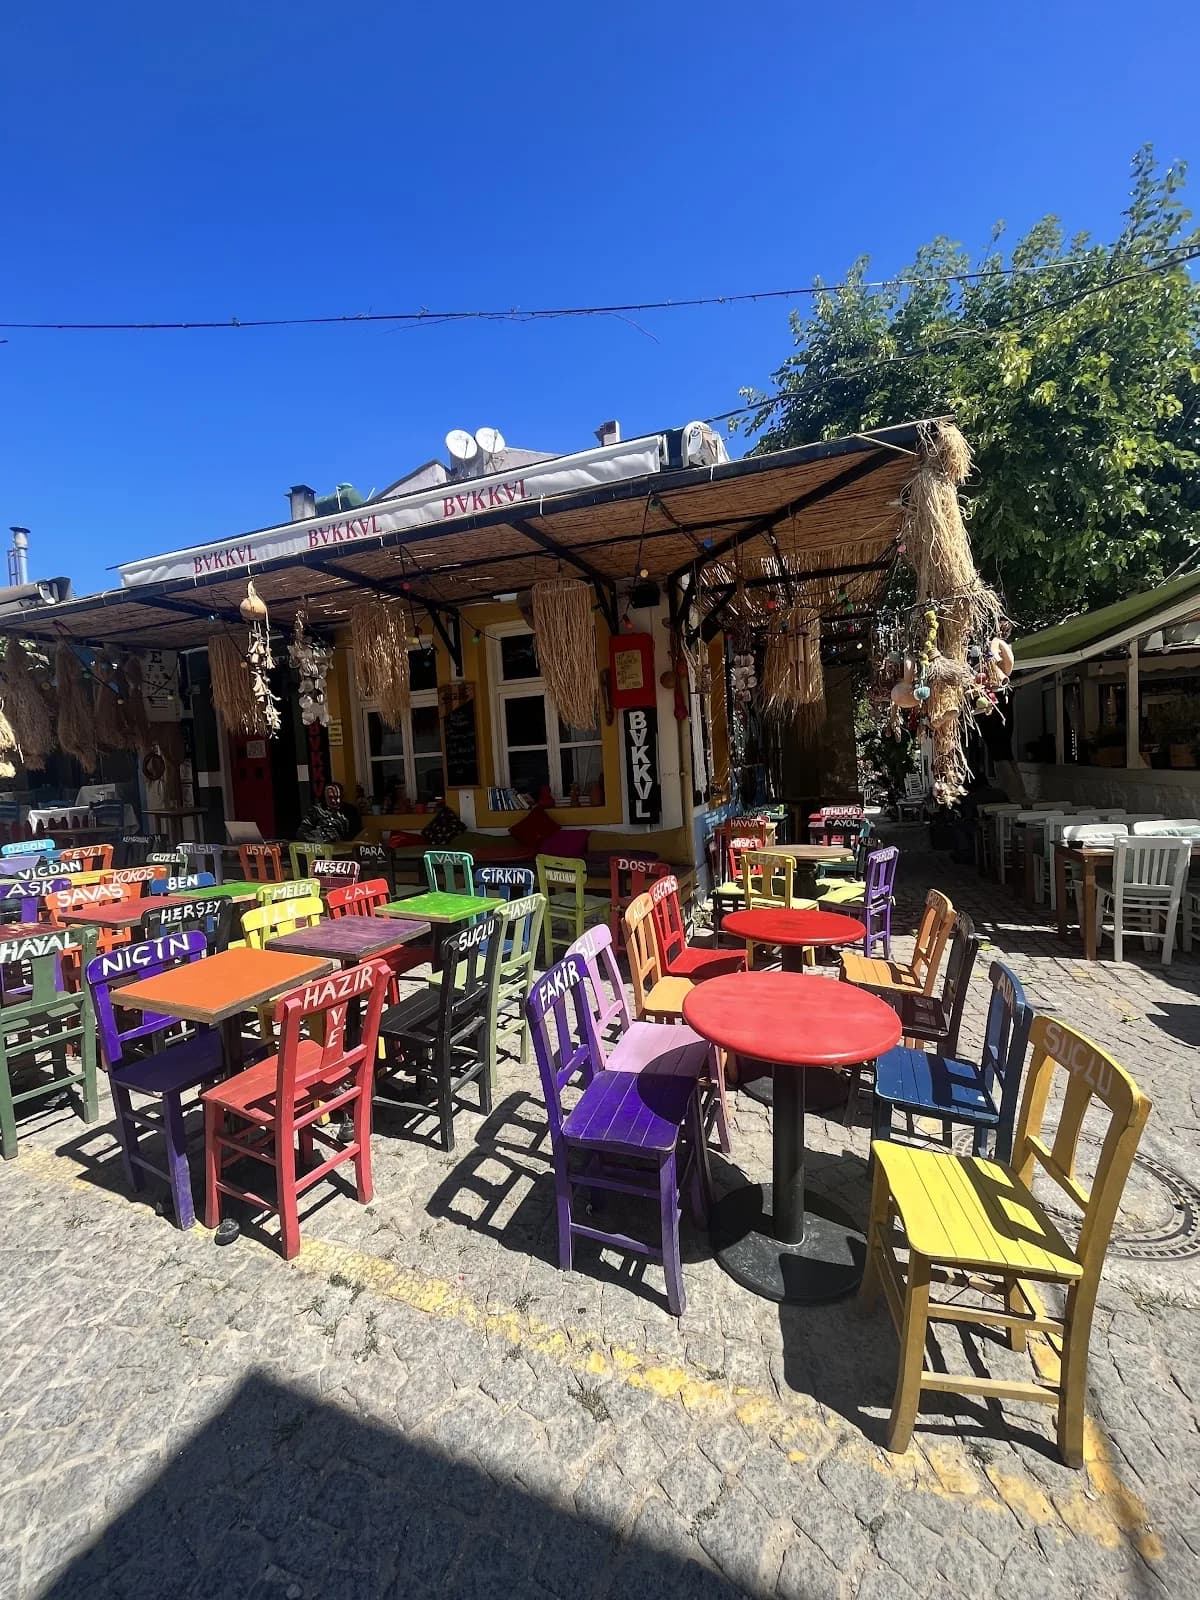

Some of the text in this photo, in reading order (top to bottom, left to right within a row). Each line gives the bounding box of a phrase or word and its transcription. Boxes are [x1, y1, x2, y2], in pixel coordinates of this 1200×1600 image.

[434, 854, 463, 864] VAR
[618, 858, 656, 873] DOST
[5, 879, 55, 899] AŞK
[166, 874, 198, 891] BEN
[344, 885, 377, 900] LAL
[160, 899, 222, 924] HERŞEY
[458, 918, 496, 952] SUÇLU
[102, 933, 191, 977] NİÇİN
[303, 965, 374, 1010] HAZIR
[326, 1007, 344, 1049] VE
[1043, 1022, 1113, 1097] SUÇLU
